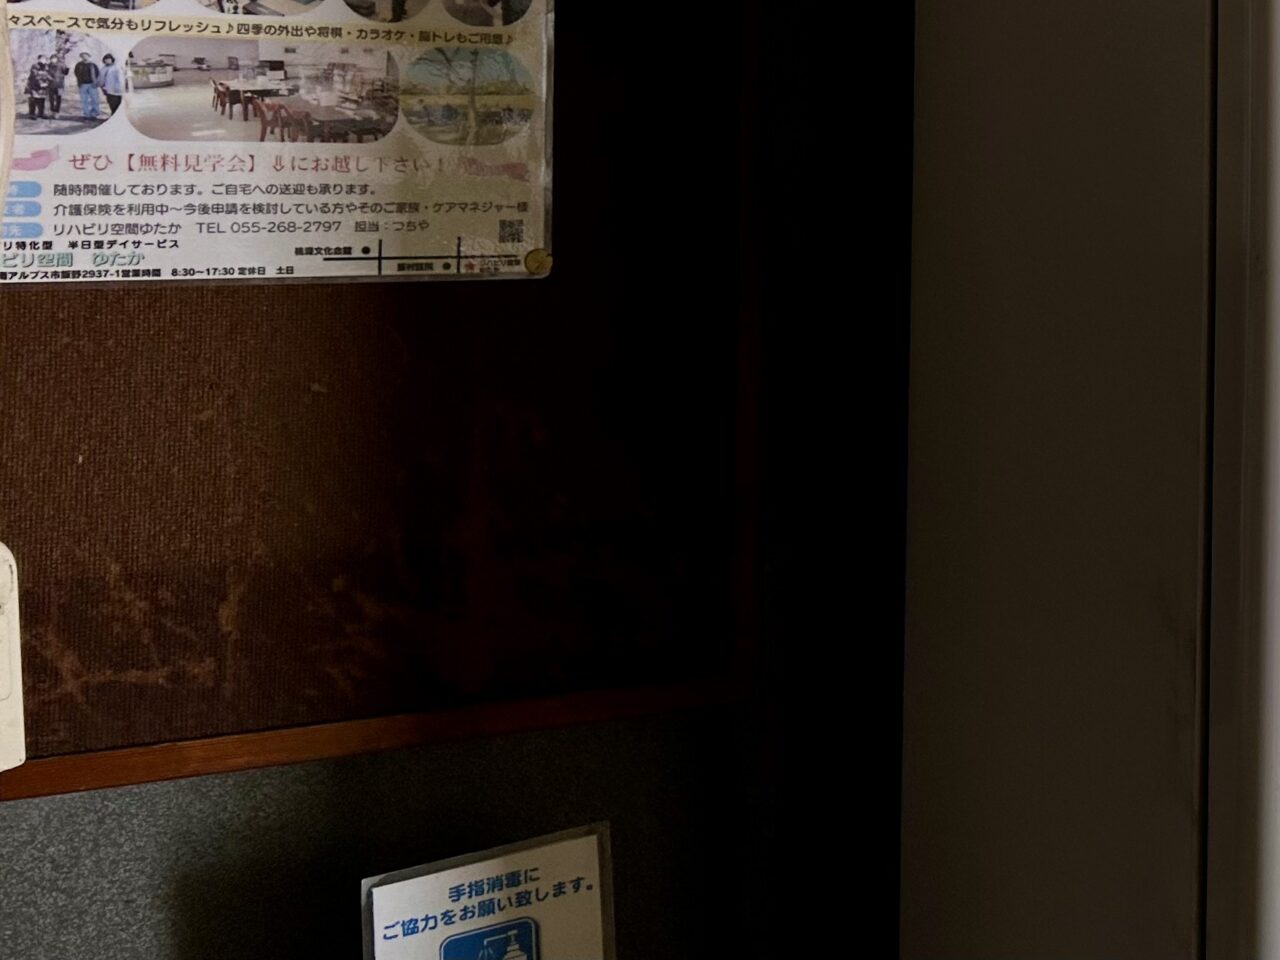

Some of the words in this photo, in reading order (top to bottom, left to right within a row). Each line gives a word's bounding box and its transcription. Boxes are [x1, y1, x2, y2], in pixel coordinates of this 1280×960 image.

[53, 223, 182, 236] リハビリ空間ゆたか
[196, 222, 226, 234] TEL
[230, 221, 342, 235] 055-268-2797
[68, 240, 180, 250] 半日型デイサービス
[92, 251, 146, 266] ゆたか
[448, 867, 541, 903] 手指消毒に
[383, 877, 594, 940] ご協力をお願い致します。
